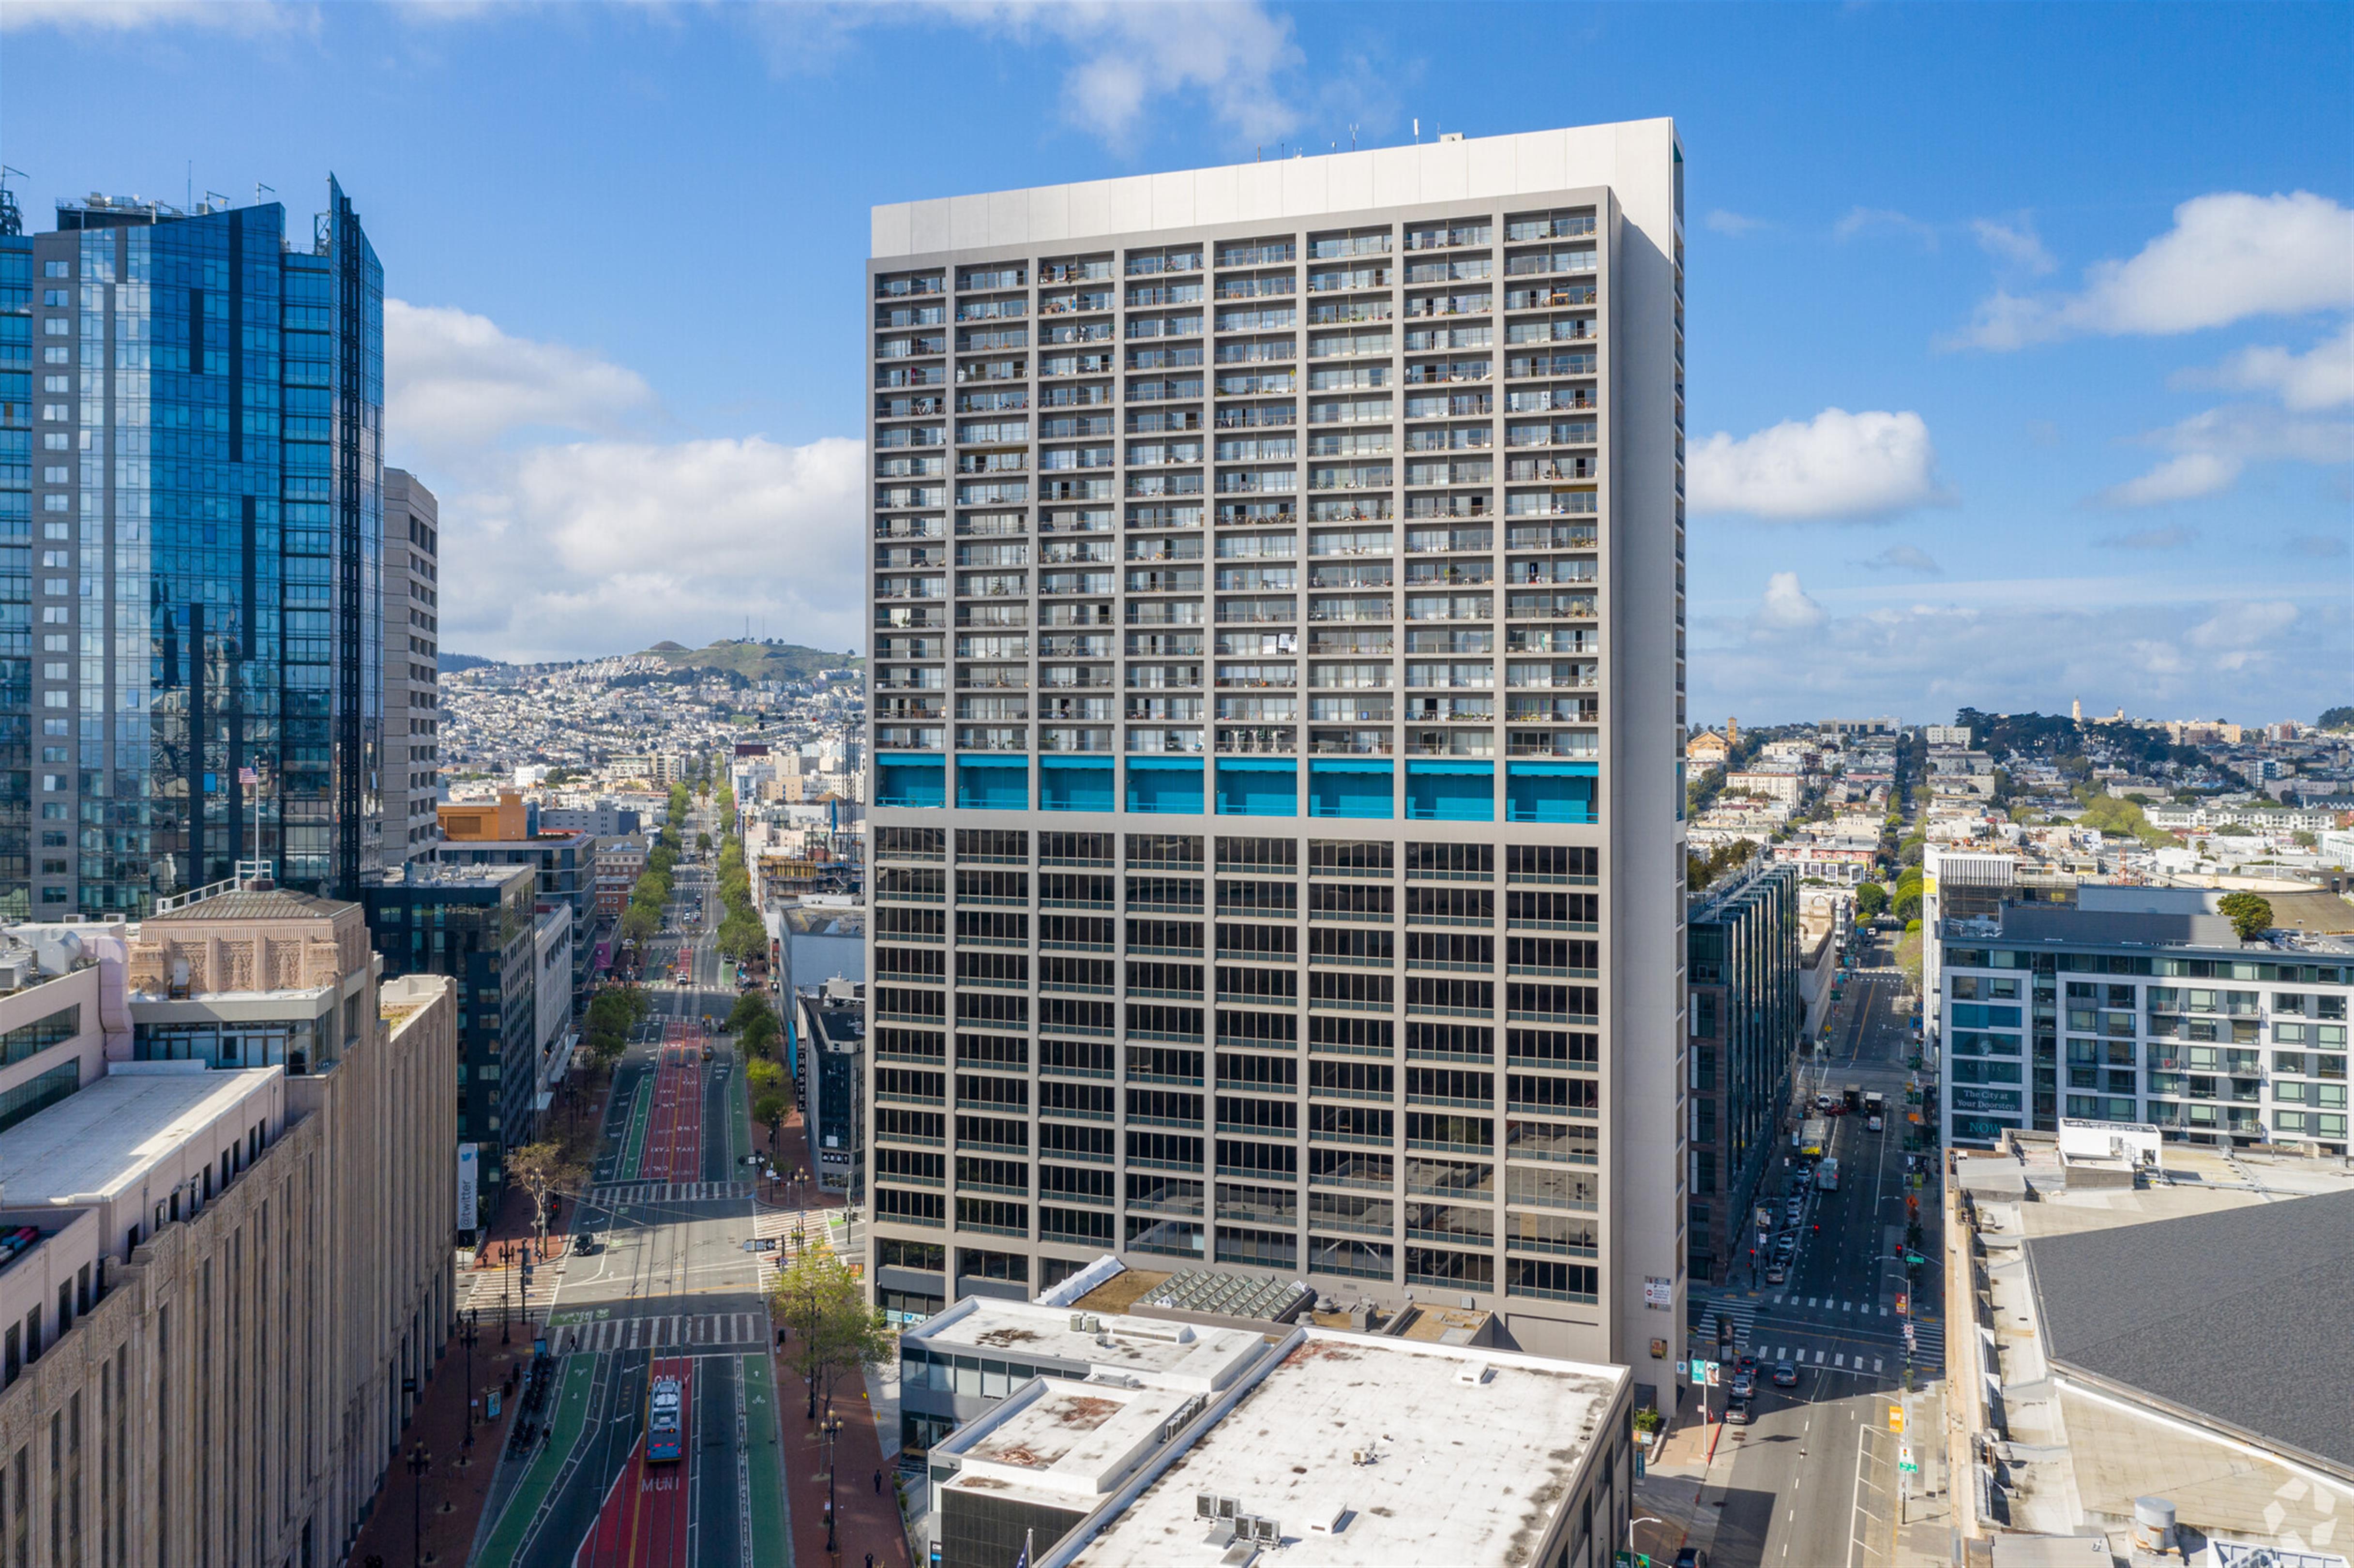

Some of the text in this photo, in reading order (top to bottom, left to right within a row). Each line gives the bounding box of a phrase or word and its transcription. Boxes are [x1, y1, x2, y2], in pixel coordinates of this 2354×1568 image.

[1968, 1063, 2005, 1072] CIVIC
[1964, 1089, 1980, 1098] The
[1981, 1090, 1998, 1100] City
[1957, 1100, 2015, 1111] Your Doorstep
[1969, 1122, 2004, 1134] NOW
[461, 1180, 473, 1228] @twitter
[641, 1477, 679, 1493] MUNI
